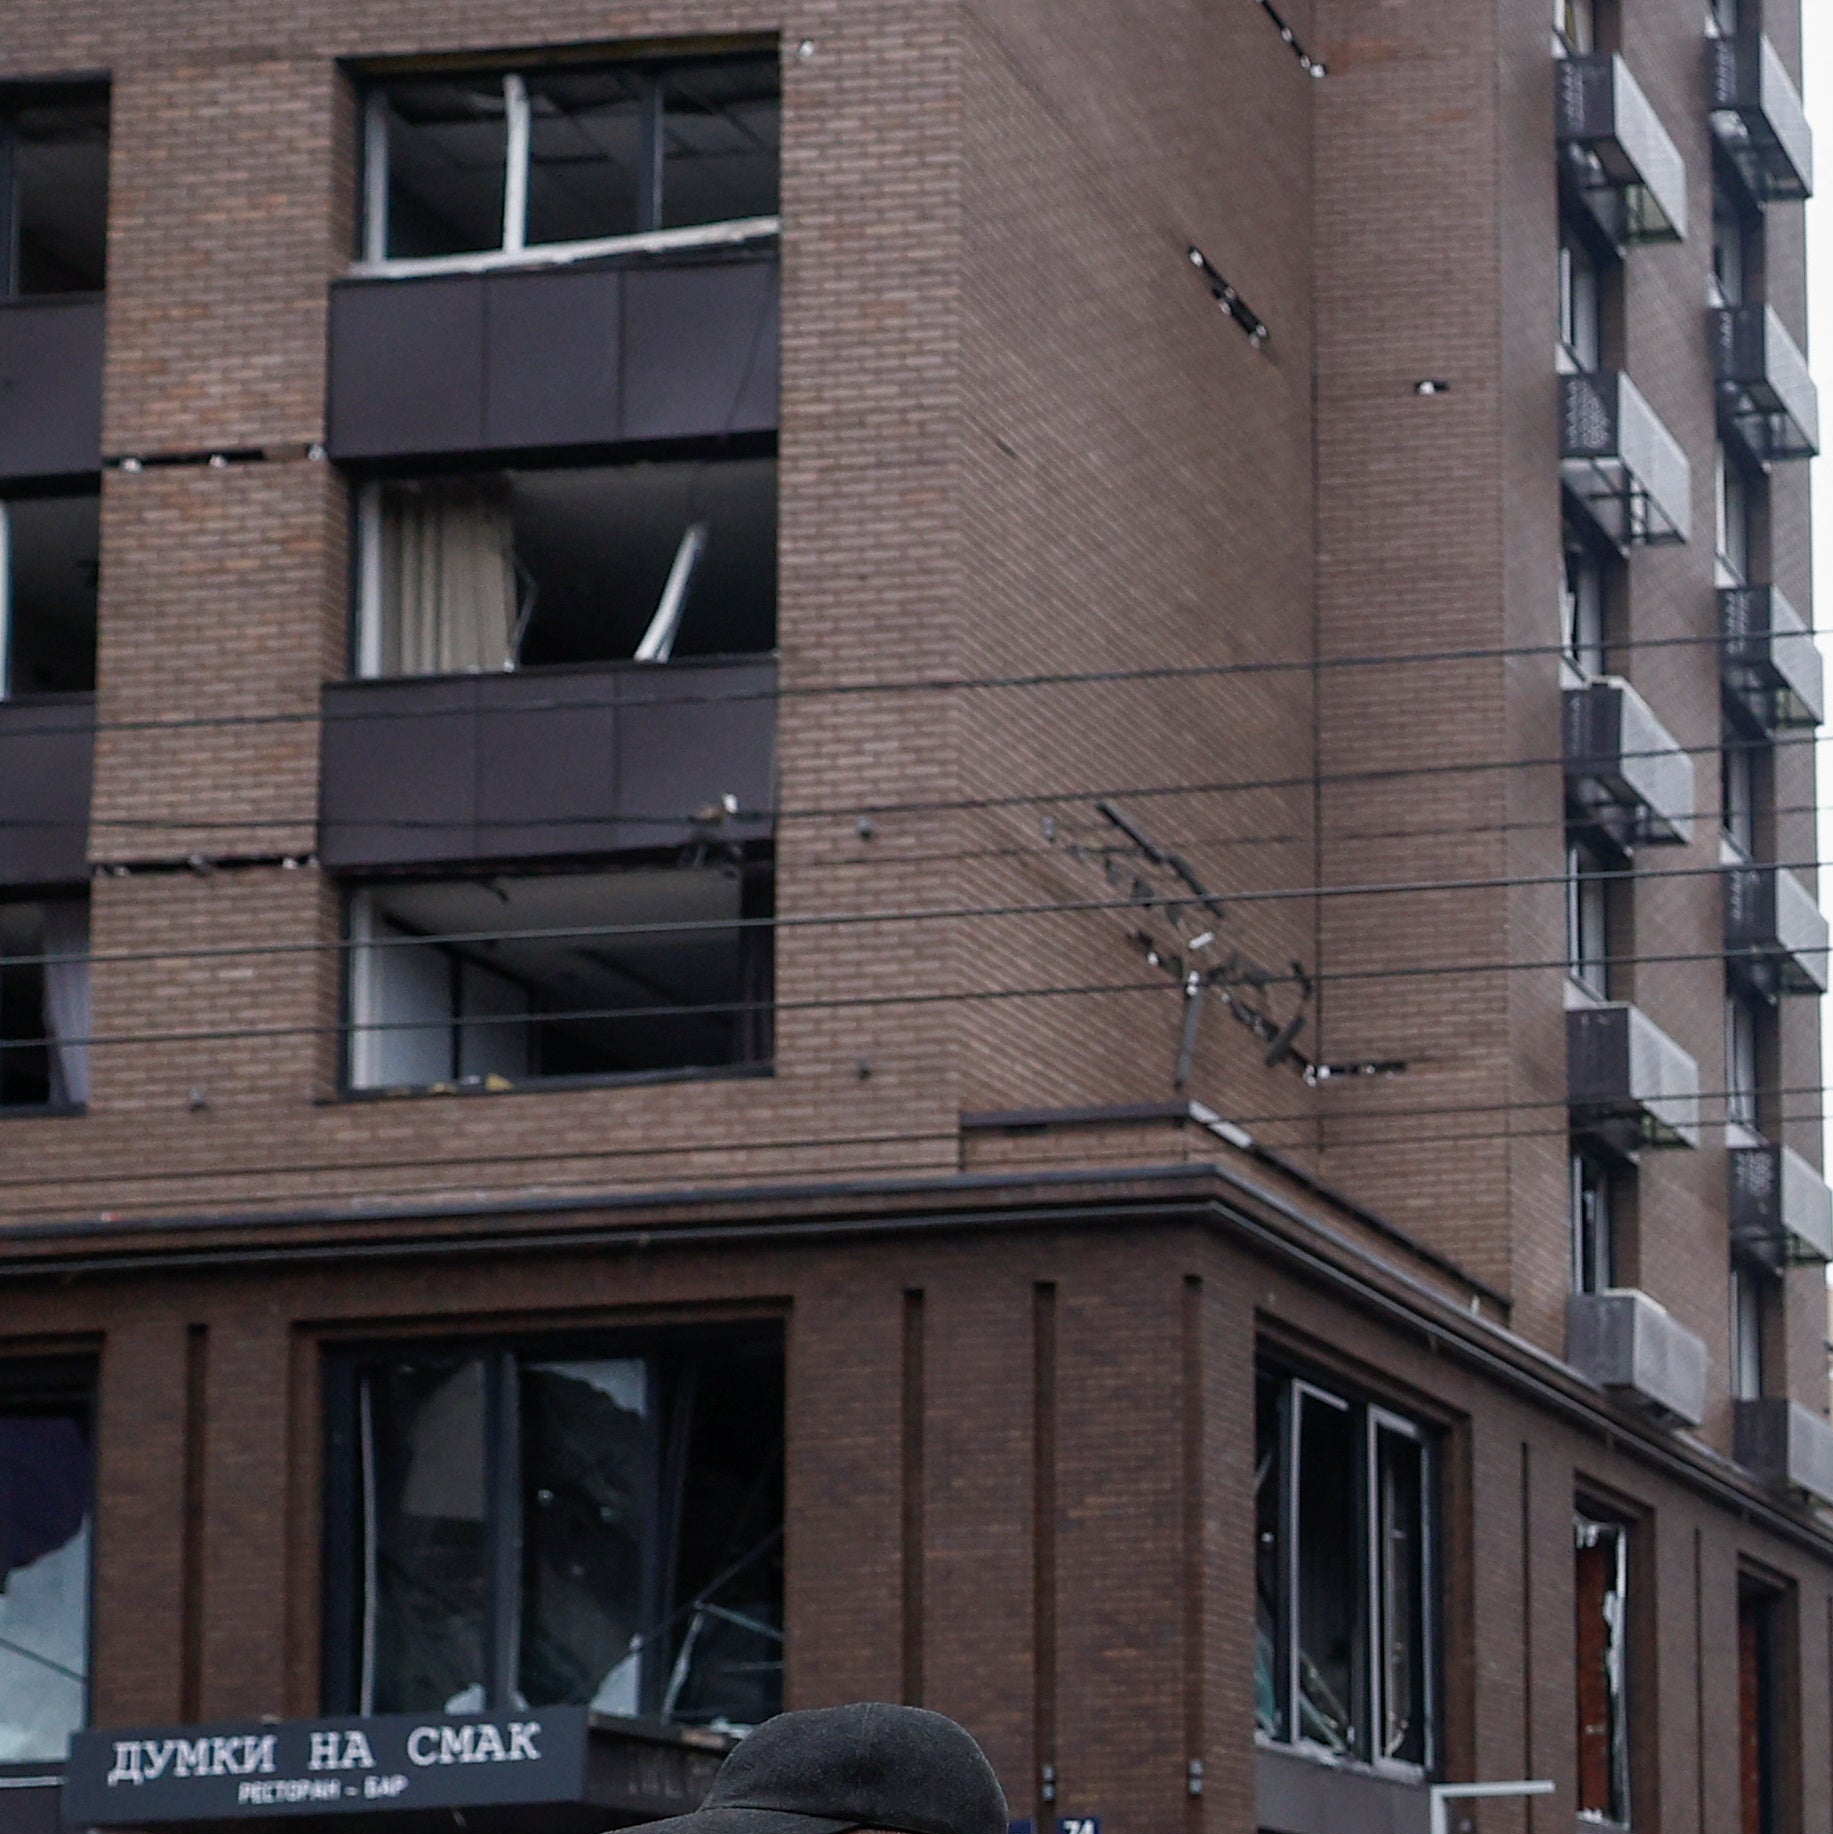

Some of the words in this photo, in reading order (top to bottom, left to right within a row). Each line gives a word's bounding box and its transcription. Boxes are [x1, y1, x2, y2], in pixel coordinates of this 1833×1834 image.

[107, 1734, 278, 1787] ДУМКИ
[308, 1730, 377, 1770] НА
[407, 1721, 542, 1766] СМАК
[238, 1777, 341, 1804] РЕСТОРАН
[363, 1774, 409, 1799] БАР
